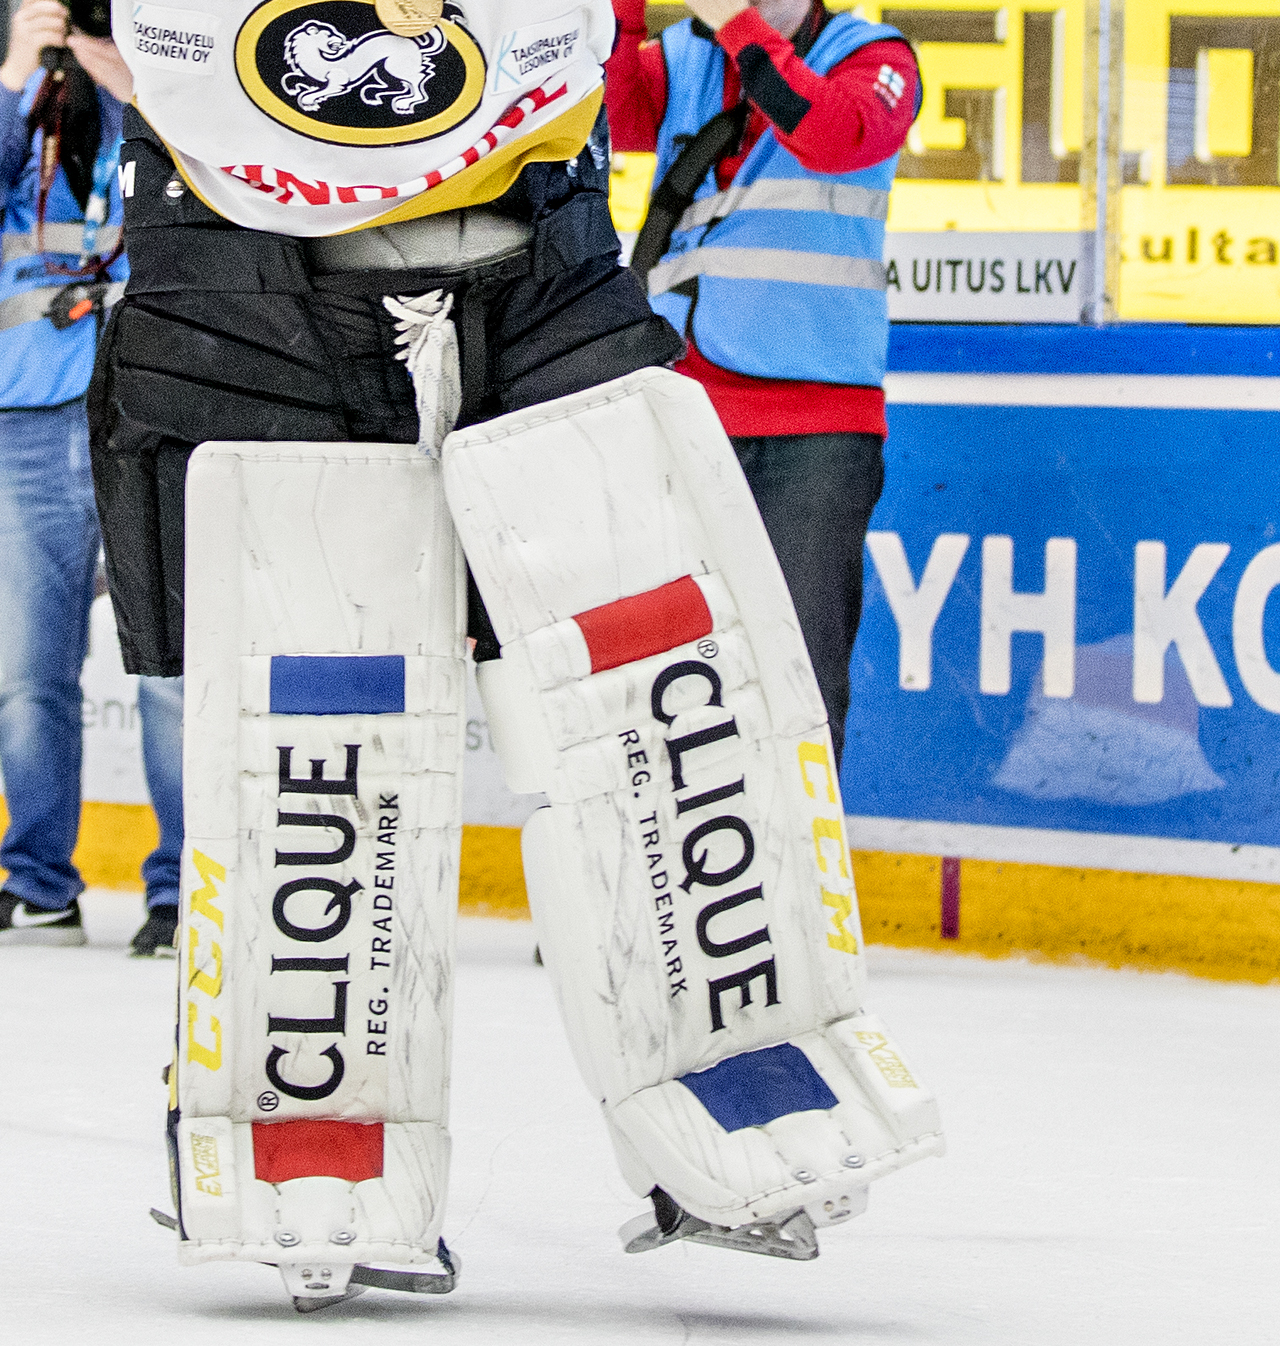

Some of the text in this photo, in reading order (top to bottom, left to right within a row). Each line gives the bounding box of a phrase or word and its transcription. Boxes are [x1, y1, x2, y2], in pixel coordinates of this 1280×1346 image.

[912, 257, 1005, 294] UITUS
[1016, 258, 1077, 294] LKV
[186, 847, 227, 1074] CCM
[365, 791, 401, 1057] REG. TRADEMARK
[618, 729, 689, 1000] REG. TRADEMARK
[798, 737, 860, 957] CCM
